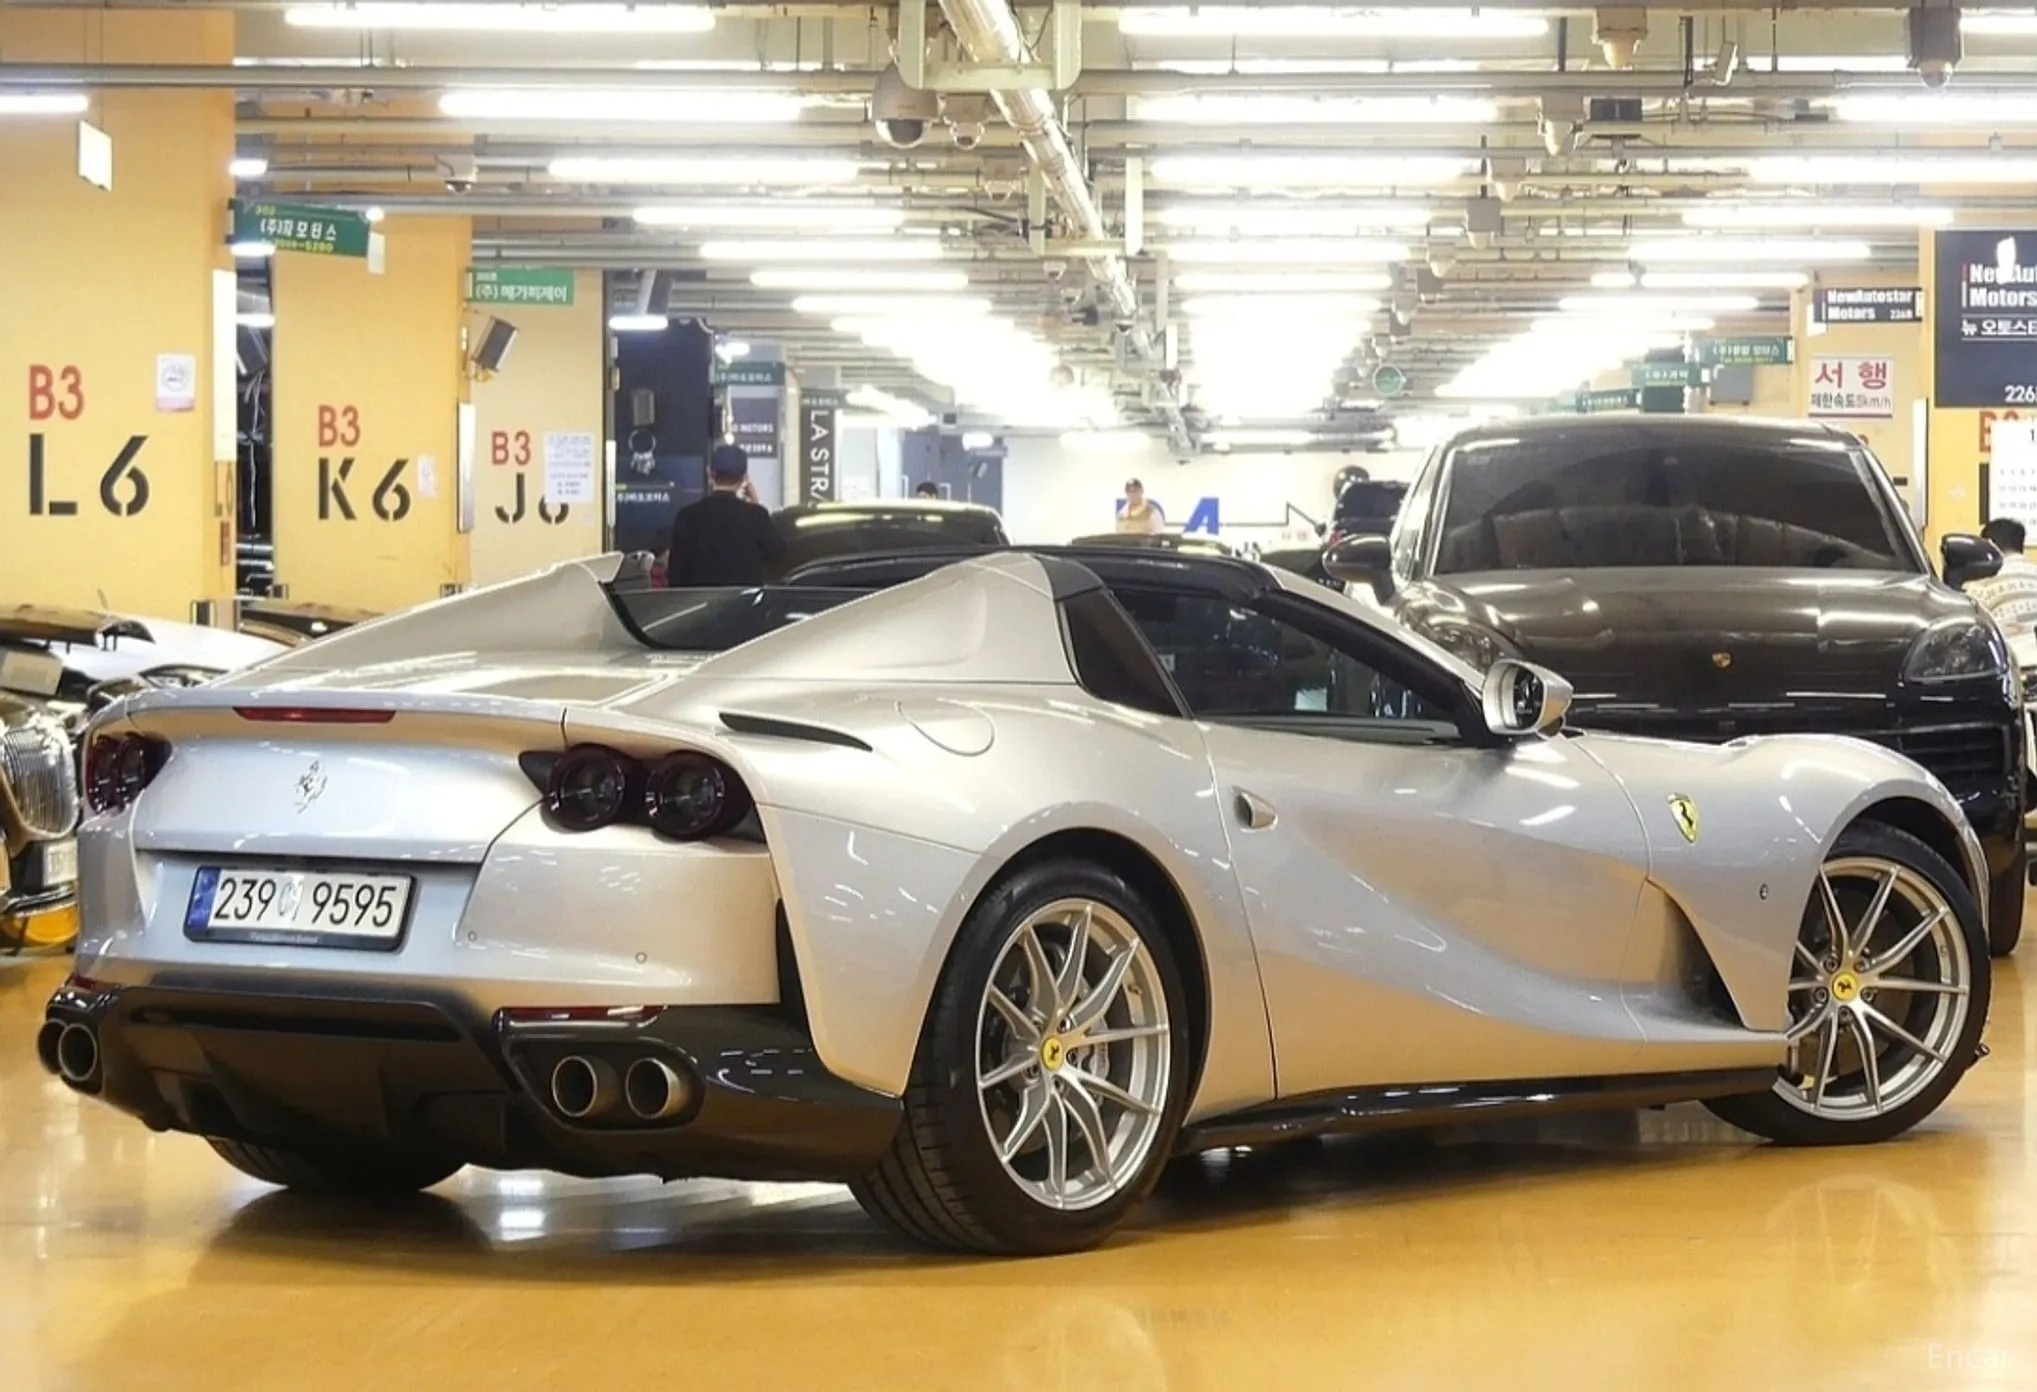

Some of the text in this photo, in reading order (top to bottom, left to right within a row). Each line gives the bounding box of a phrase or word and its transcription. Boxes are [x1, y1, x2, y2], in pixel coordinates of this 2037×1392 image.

[1827, 289, 1913, 304] NewAutostar
[1827, 306, 1876, 320] Motors
[1969, 287, 2037, 308] Motors
[1961, 318, 1978, 337] 뉴
[29, 364, 85, 421] B3
[318, 405, 361, 447] B3
[810, 409, 830, 442] LA
[491, 431, 531, 466] B3
[311, 881, 397, 928] 9595
